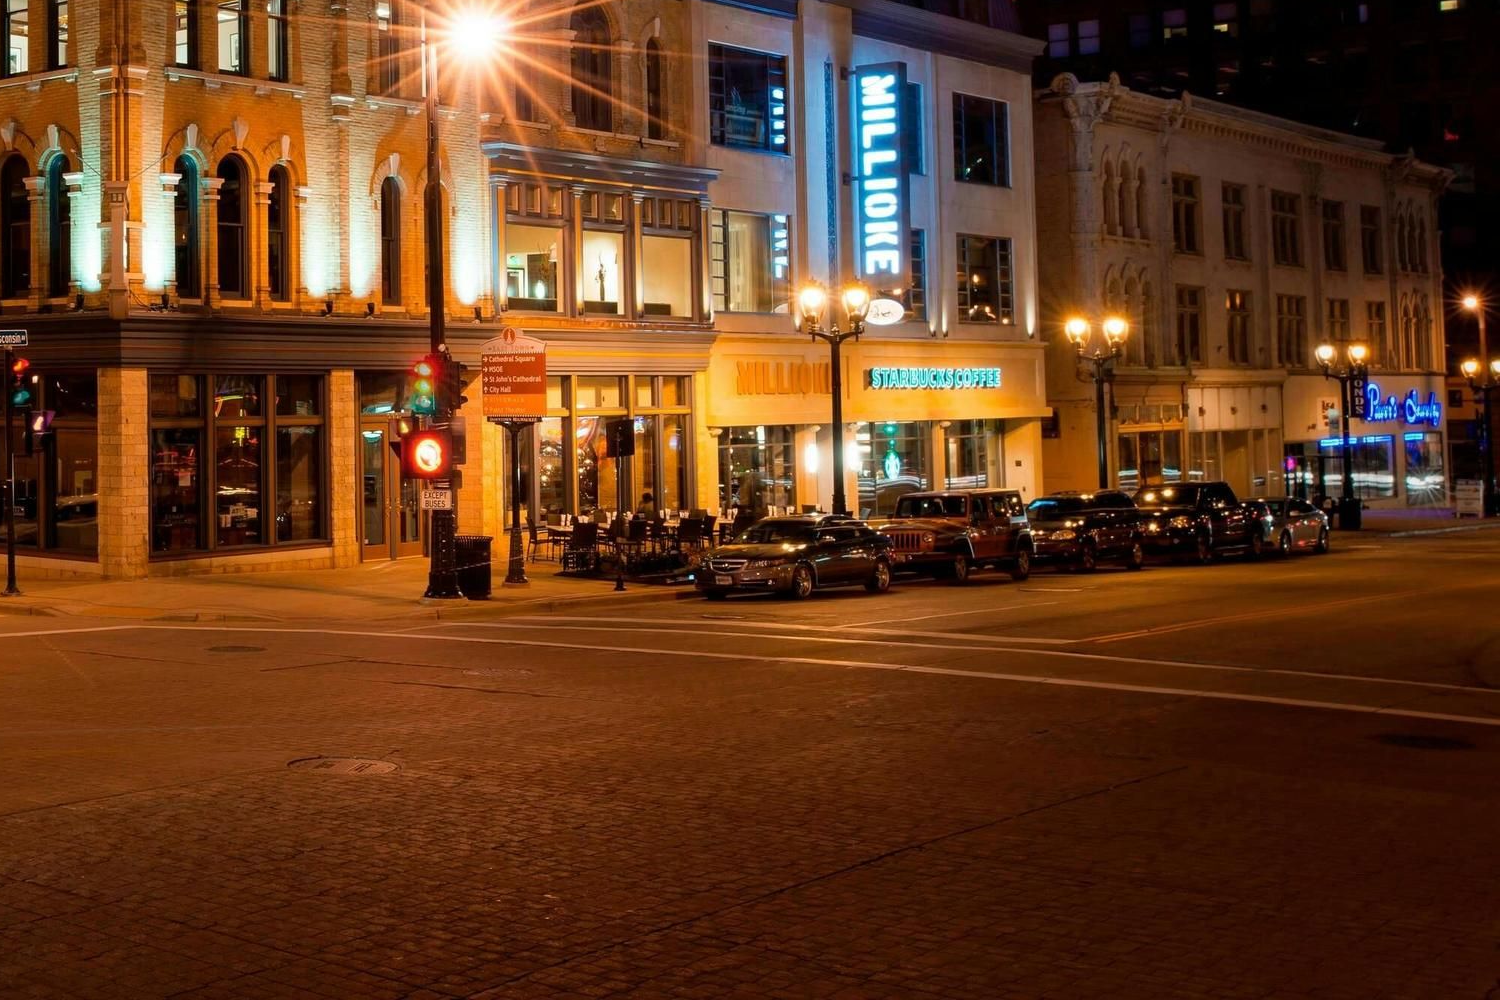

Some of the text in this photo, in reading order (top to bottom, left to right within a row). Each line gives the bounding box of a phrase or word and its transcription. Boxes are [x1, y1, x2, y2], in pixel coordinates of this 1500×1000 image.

[860, 74, 900, 275] MILLIOKE
[515, 356, 536, 364] Square
[512, 375, 542, 383] Cathedral
[871, 367, 1001, 389] STARBUCKS COFFEE
[489, 386, 500, 394] City
[1354, 370, 1364, 414] ONDS
[423, 491, 447, 499] EXCEPT
[424, 500, 446, 508] BUSES
